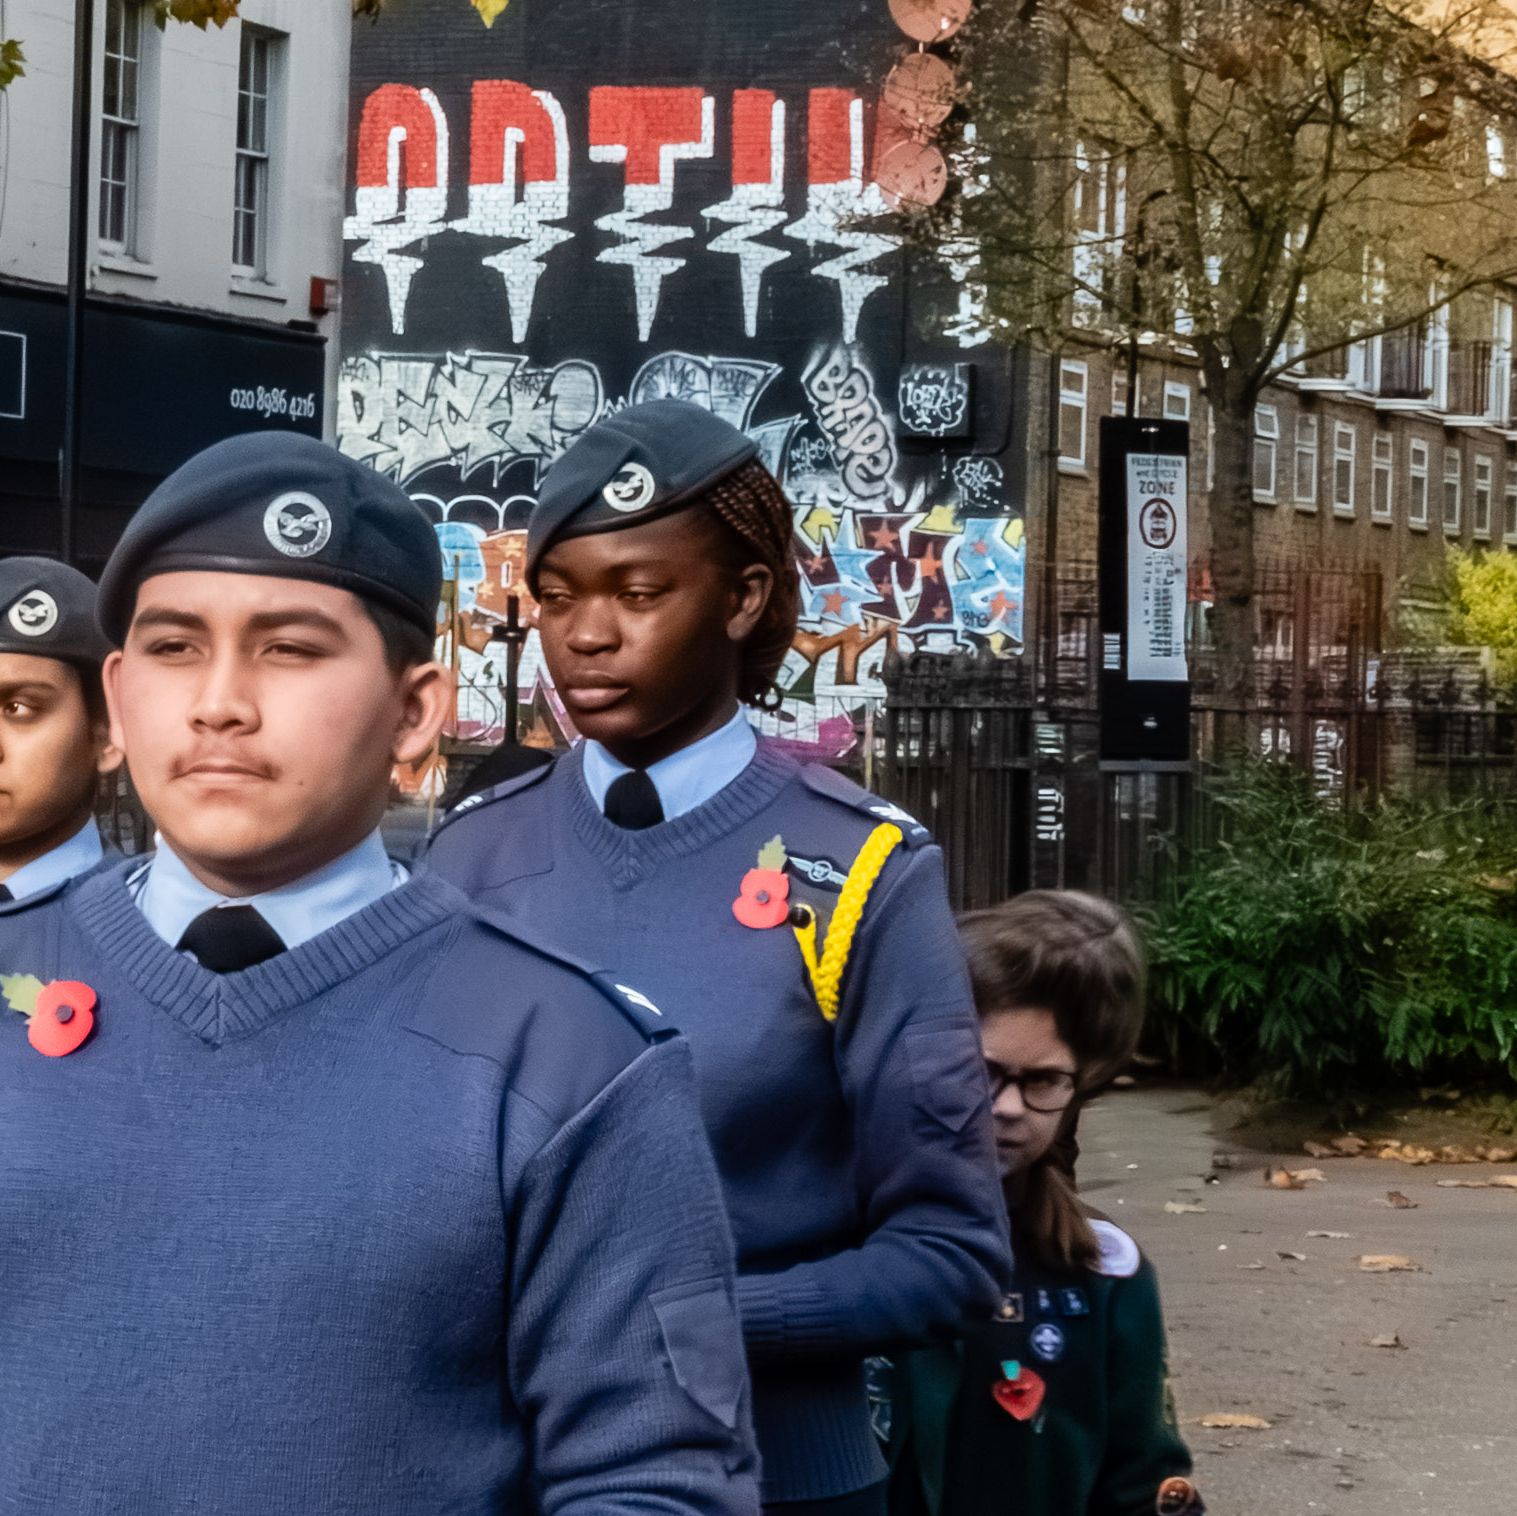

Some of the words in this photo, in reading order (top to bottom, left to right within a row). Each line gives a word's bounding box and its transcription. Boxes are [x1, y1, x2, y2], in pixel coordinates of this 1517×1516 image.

[230, 388, 255, 410] 020
[256, 385, 288, 418] 8986
[288, 392, 316, 422] 4216
[1138, 480, 1176, 495] ZONE
